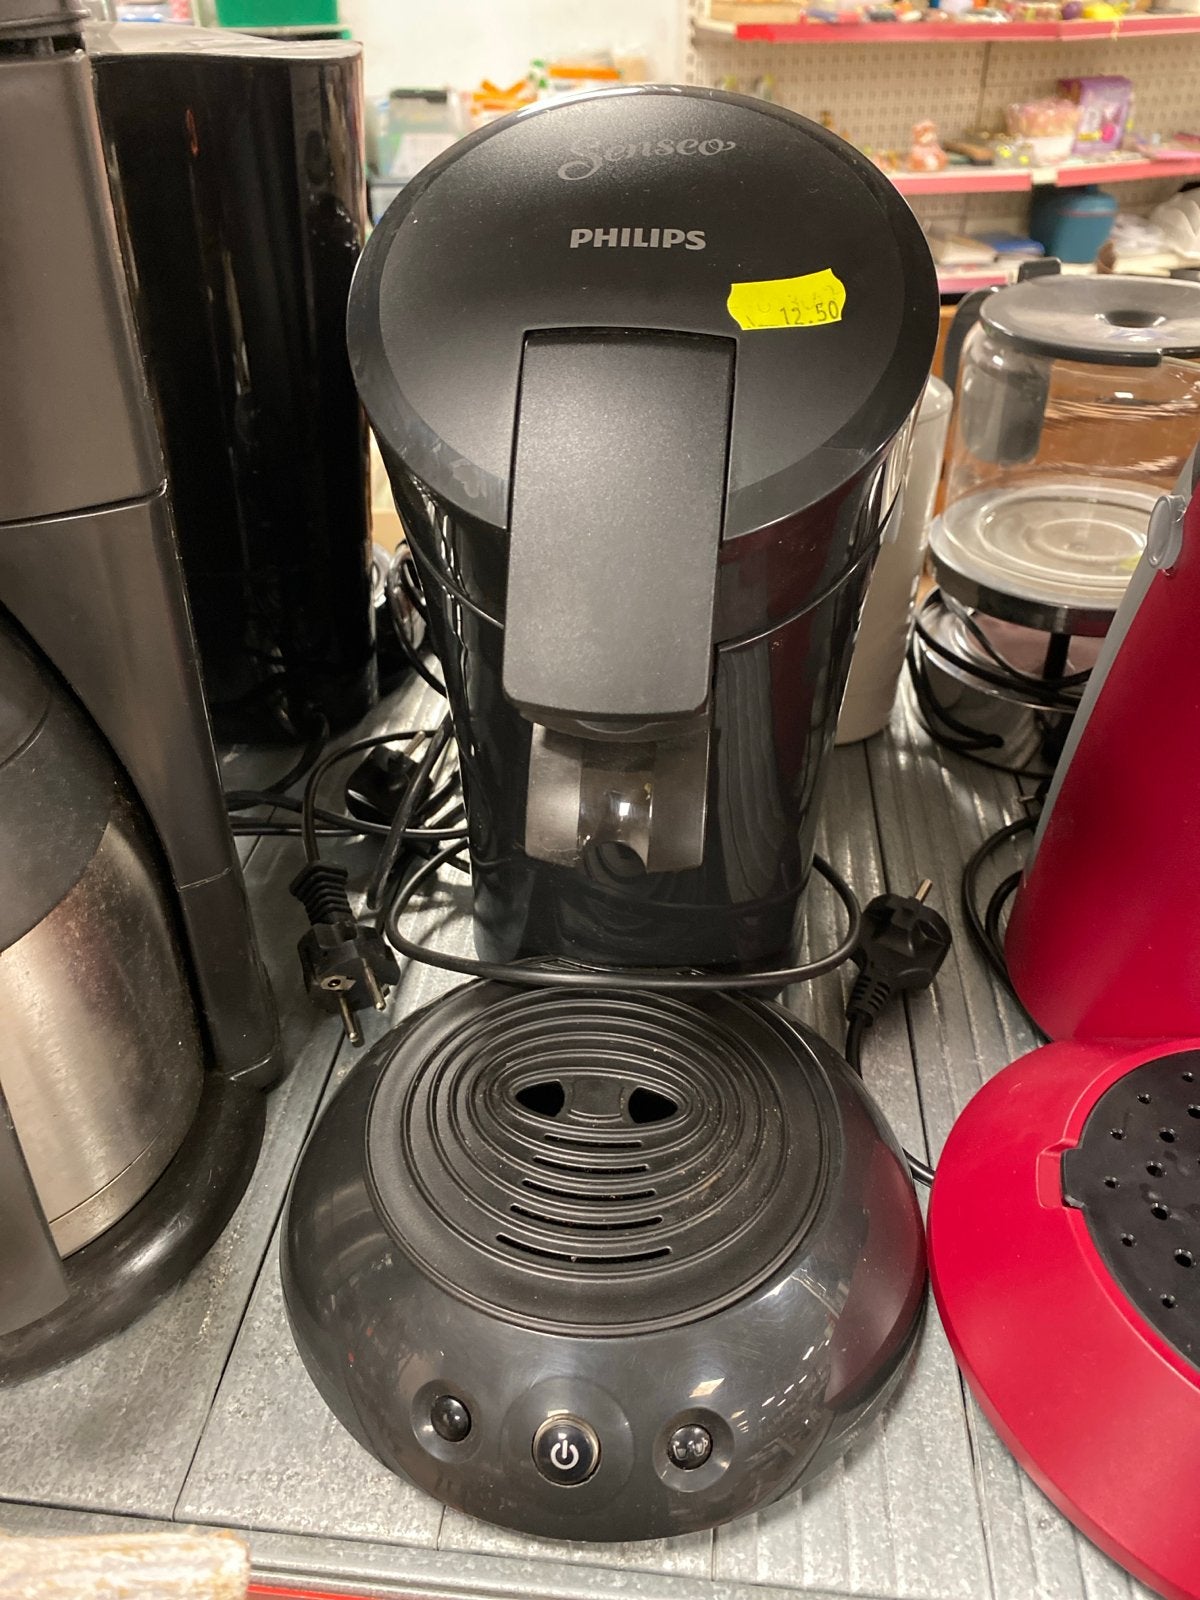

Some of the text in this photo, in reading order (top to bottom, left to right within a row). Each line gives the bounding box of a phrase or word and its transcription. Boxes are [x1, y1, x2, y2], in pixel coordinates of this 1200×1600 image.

[557, 137, 736, 180] Senseo
[570, 228, 707, 250] PHILIPS
[780, 300, 839, 325] 12.50
